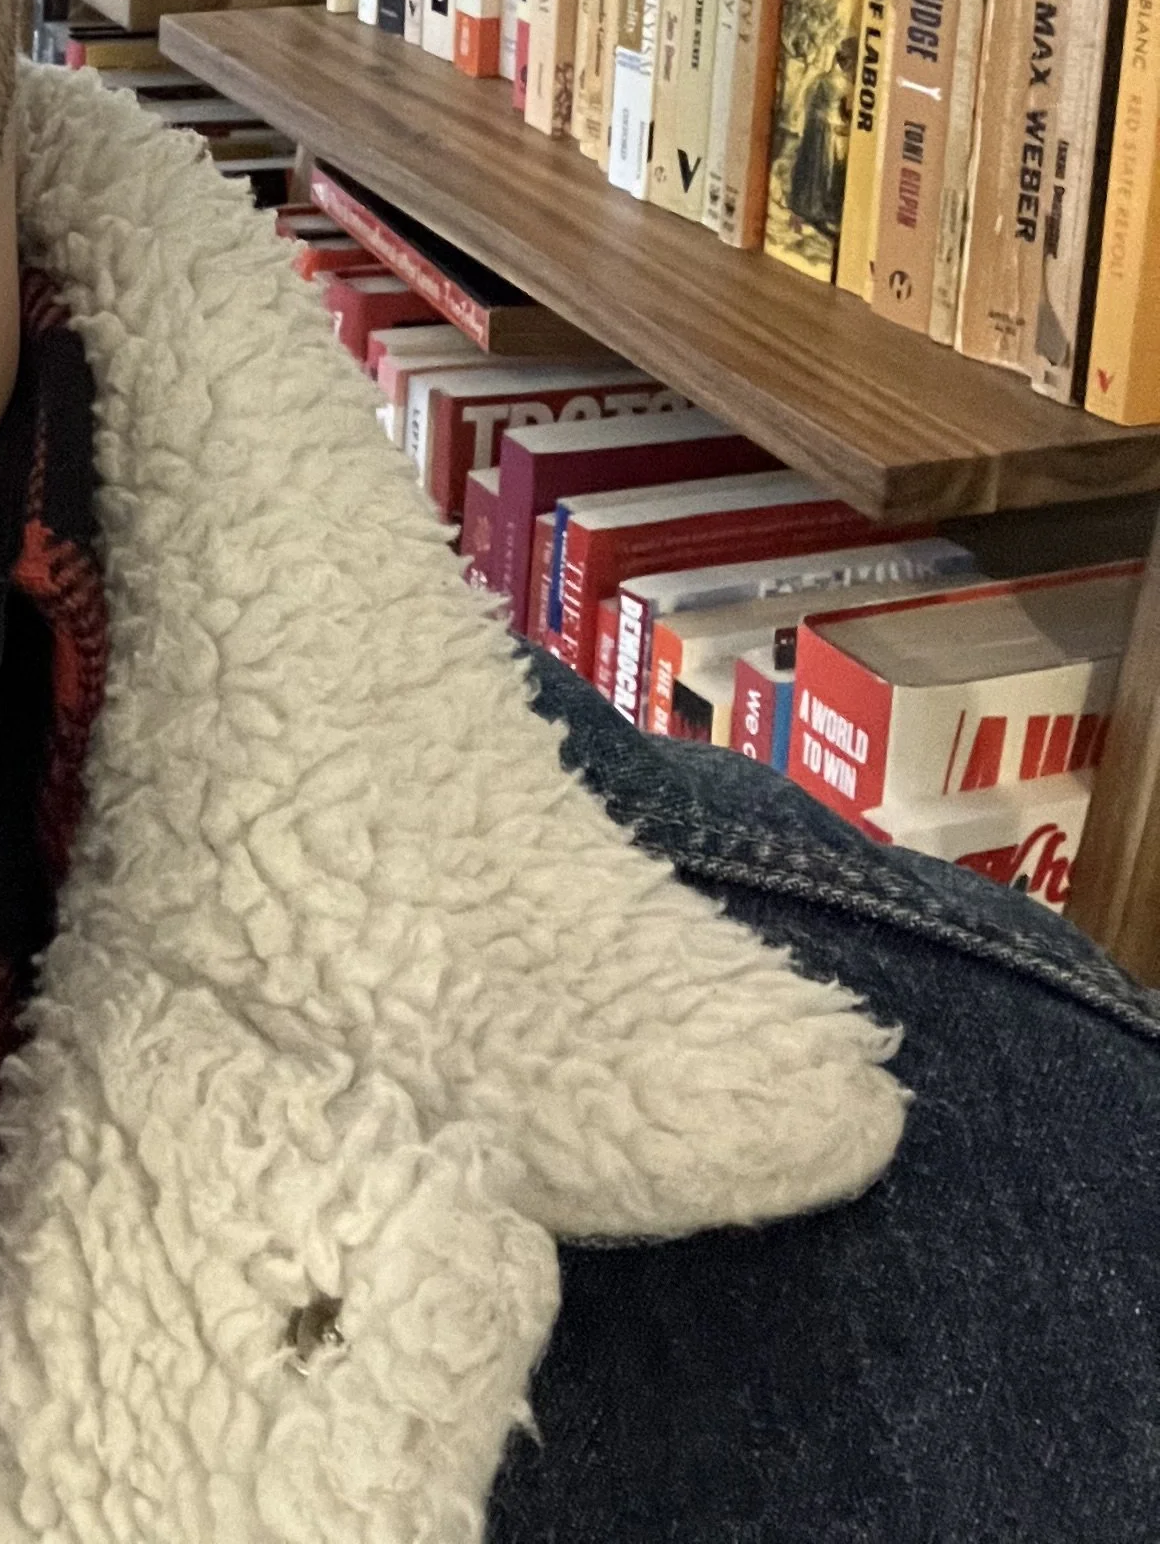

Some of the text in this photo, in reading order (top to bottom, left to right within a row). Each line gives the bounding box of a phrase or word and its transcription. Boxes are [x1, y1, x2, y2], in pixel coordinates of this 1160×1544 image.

[690, 28, 702, 71] STATE
[1027, 1, 1058, 88] MAX
[858, 27, 883, 134] LABOR
[1123, 93, 1143, 132] RED
[901, 121, 927, 164] TONI
[1014, 109, 1048, 243] WEBER
[1116, 139, 1139, 201] STATE
[895, 167, 922, 230] GILPIN
[1108, 206, 1132, 282] REVOLT
[562, 561, 585, 632] THE
[657, 659, 673, 699] THE
[798, 688, 870, 765] A WORLD
[802, 732, 821, 775] TO
[822, 748, 857, 802] WIN
